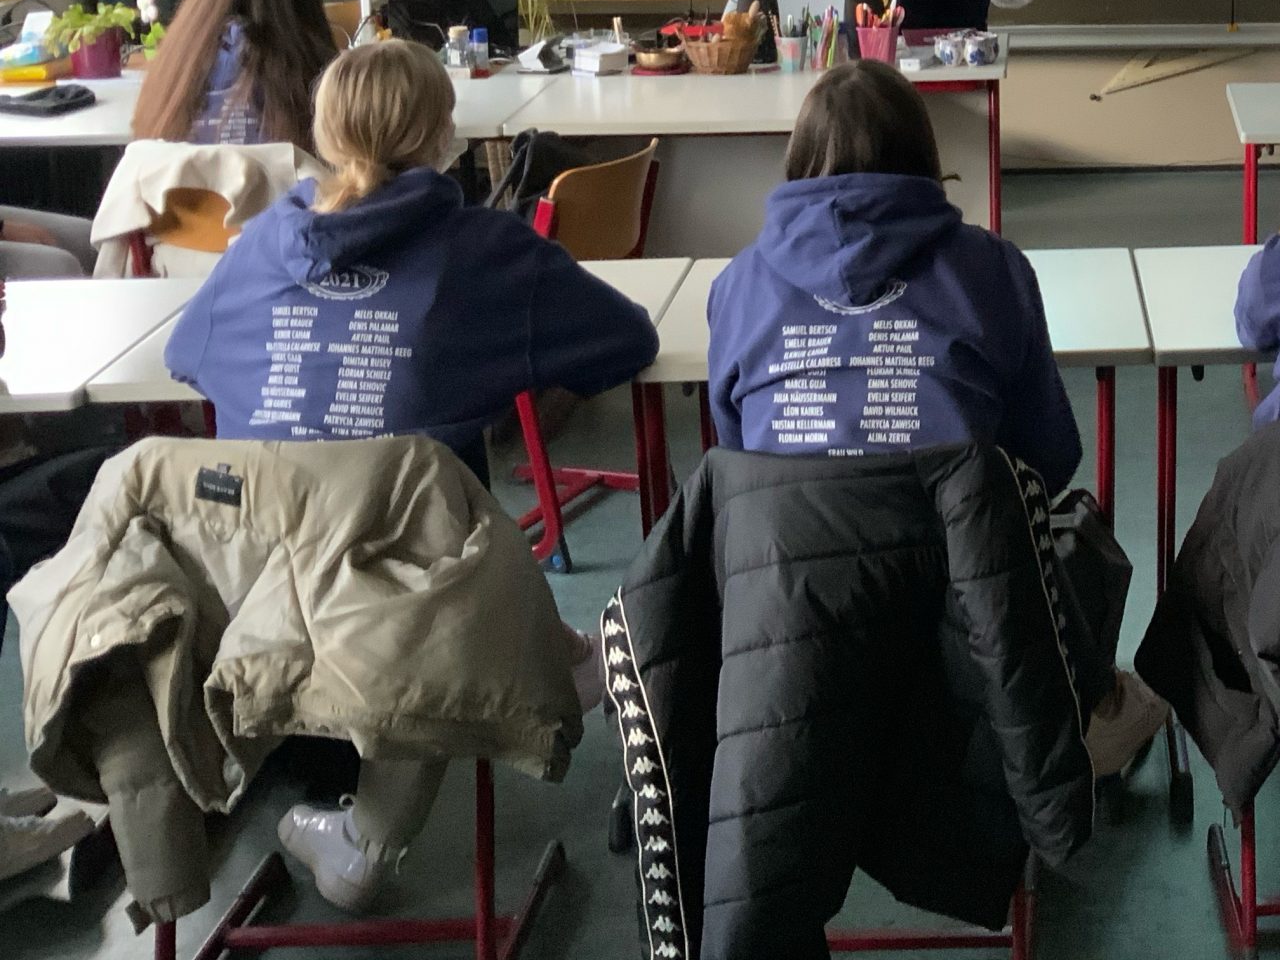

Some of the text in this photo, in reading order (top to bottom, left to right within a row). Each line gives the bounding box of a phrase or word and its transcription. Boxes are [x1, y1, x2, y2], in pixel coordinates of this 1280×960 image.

[348, 320, 368, 331] DENIS
[782, 324, 838, 336] SAMUEL BERTSCH
[873, 319, 893, 330] MELIS
[373, 334, 390, 345] PAUL
[868, 332, 888, 342] DENIS
[361, 345, 393, 357] MATTHIAS
[872, 344, 912, 354] ARTUR PAUL
[849, 356, 884, 368] JOHANNES
[884, 356, 916, 367] MATTHIAS
[338, 366, 365, 379] FLORIAN
[784, 378, 808, 390] MARCEL
[867, 379, 889, 389] EMINA
[867, 392, 890, 403] EVELIN
[329, 403, 349, 414] DAVID
[863, 406, 883, 416] DAVID
[778, 432, 803, 444] FLORIAN
[867, 432, 887, 443] ALINA
